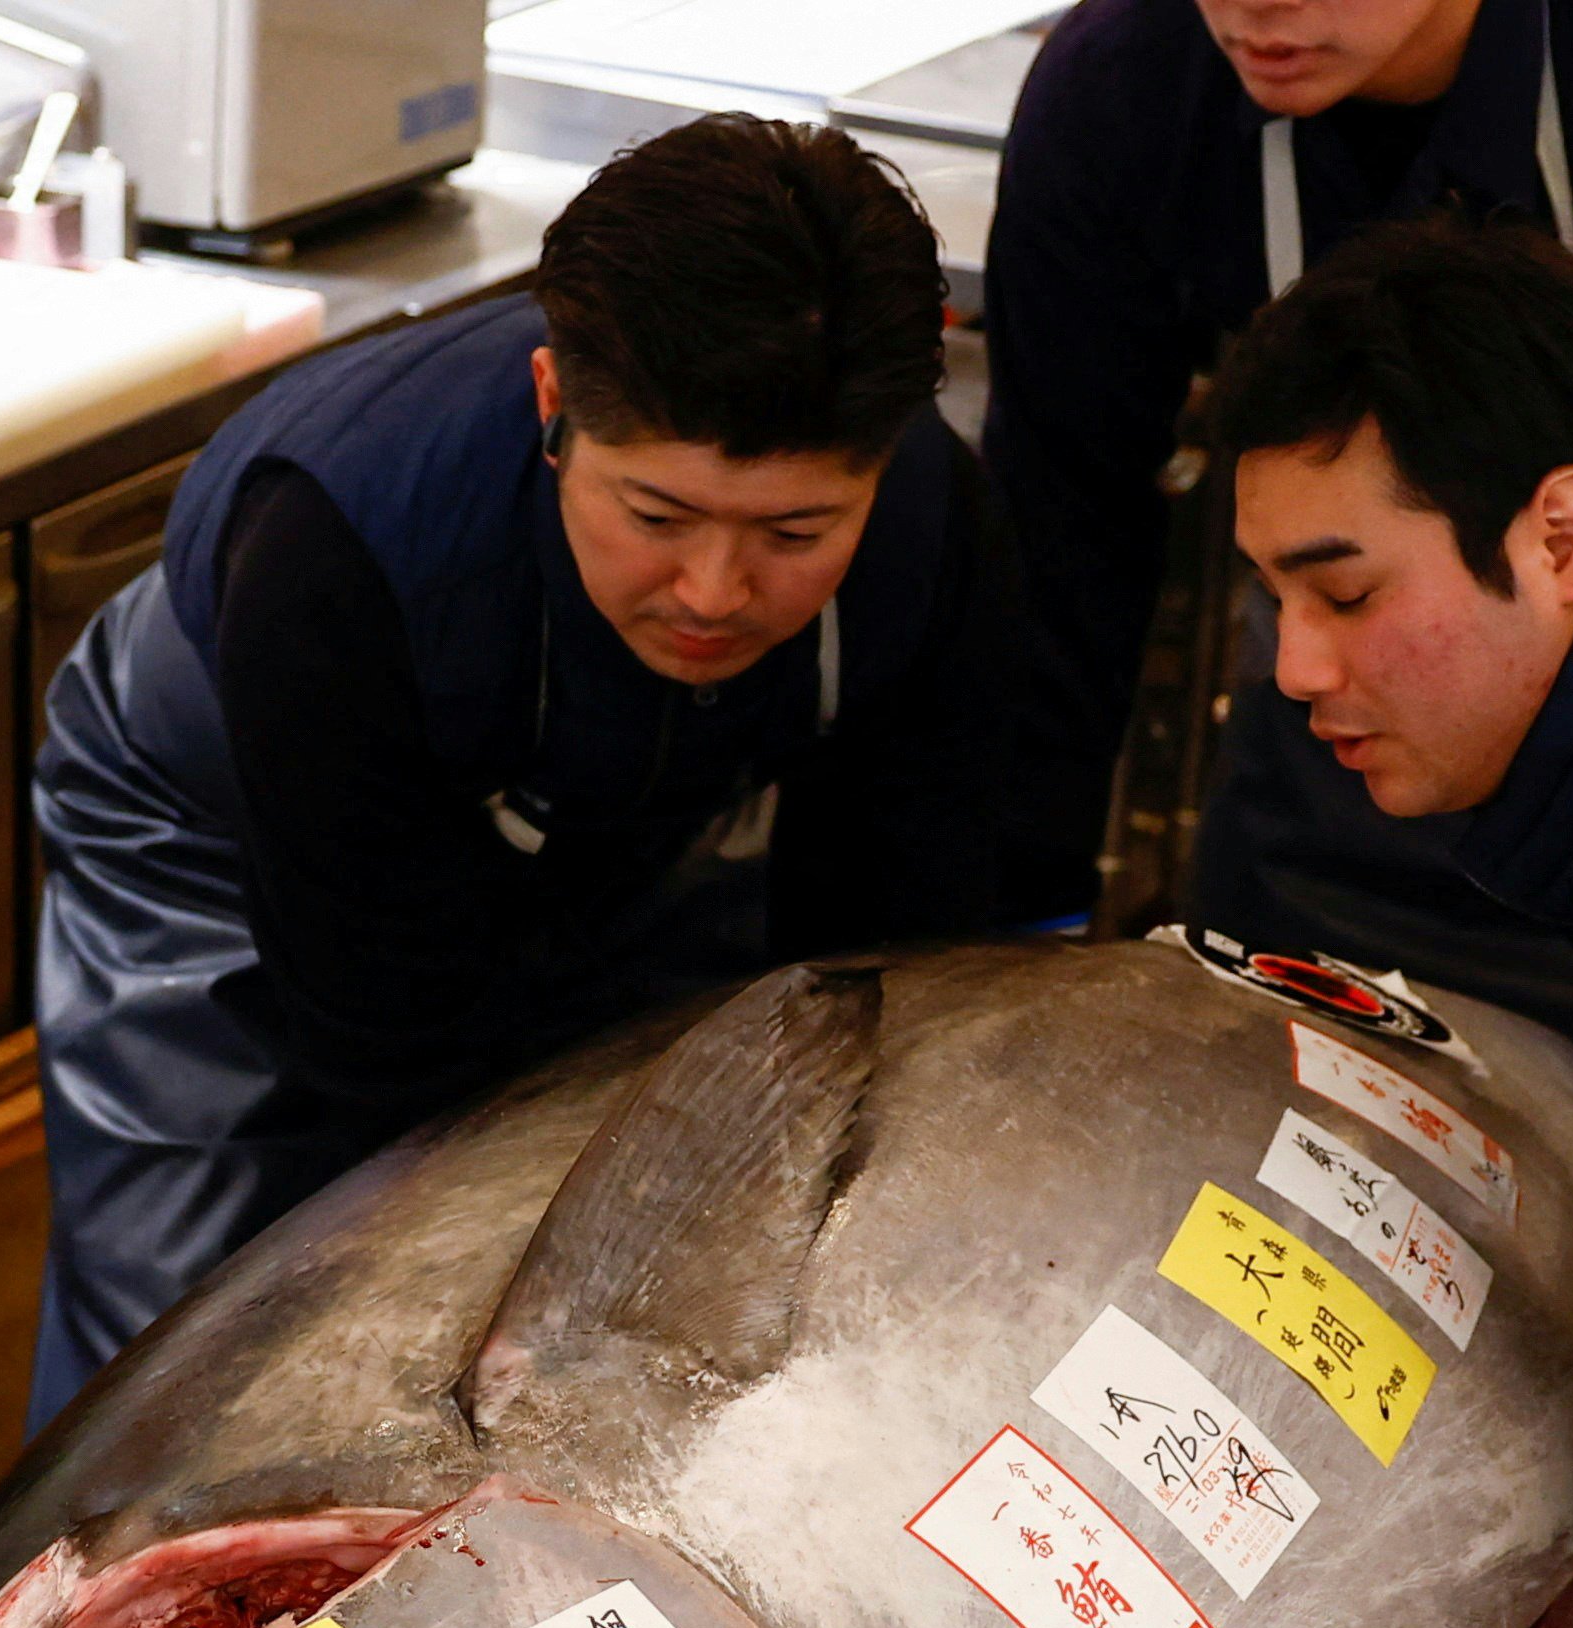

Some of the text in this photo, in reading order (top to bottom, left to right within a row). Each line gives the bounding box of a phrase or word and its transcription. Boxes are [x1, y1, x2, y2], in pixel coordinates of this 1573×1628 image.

[1217, 1210, 1327, 1292] 青森県
[1224, 1253, 1366, 1373] 大間
[1006, 1461, 1103, 1546] 令和七年
